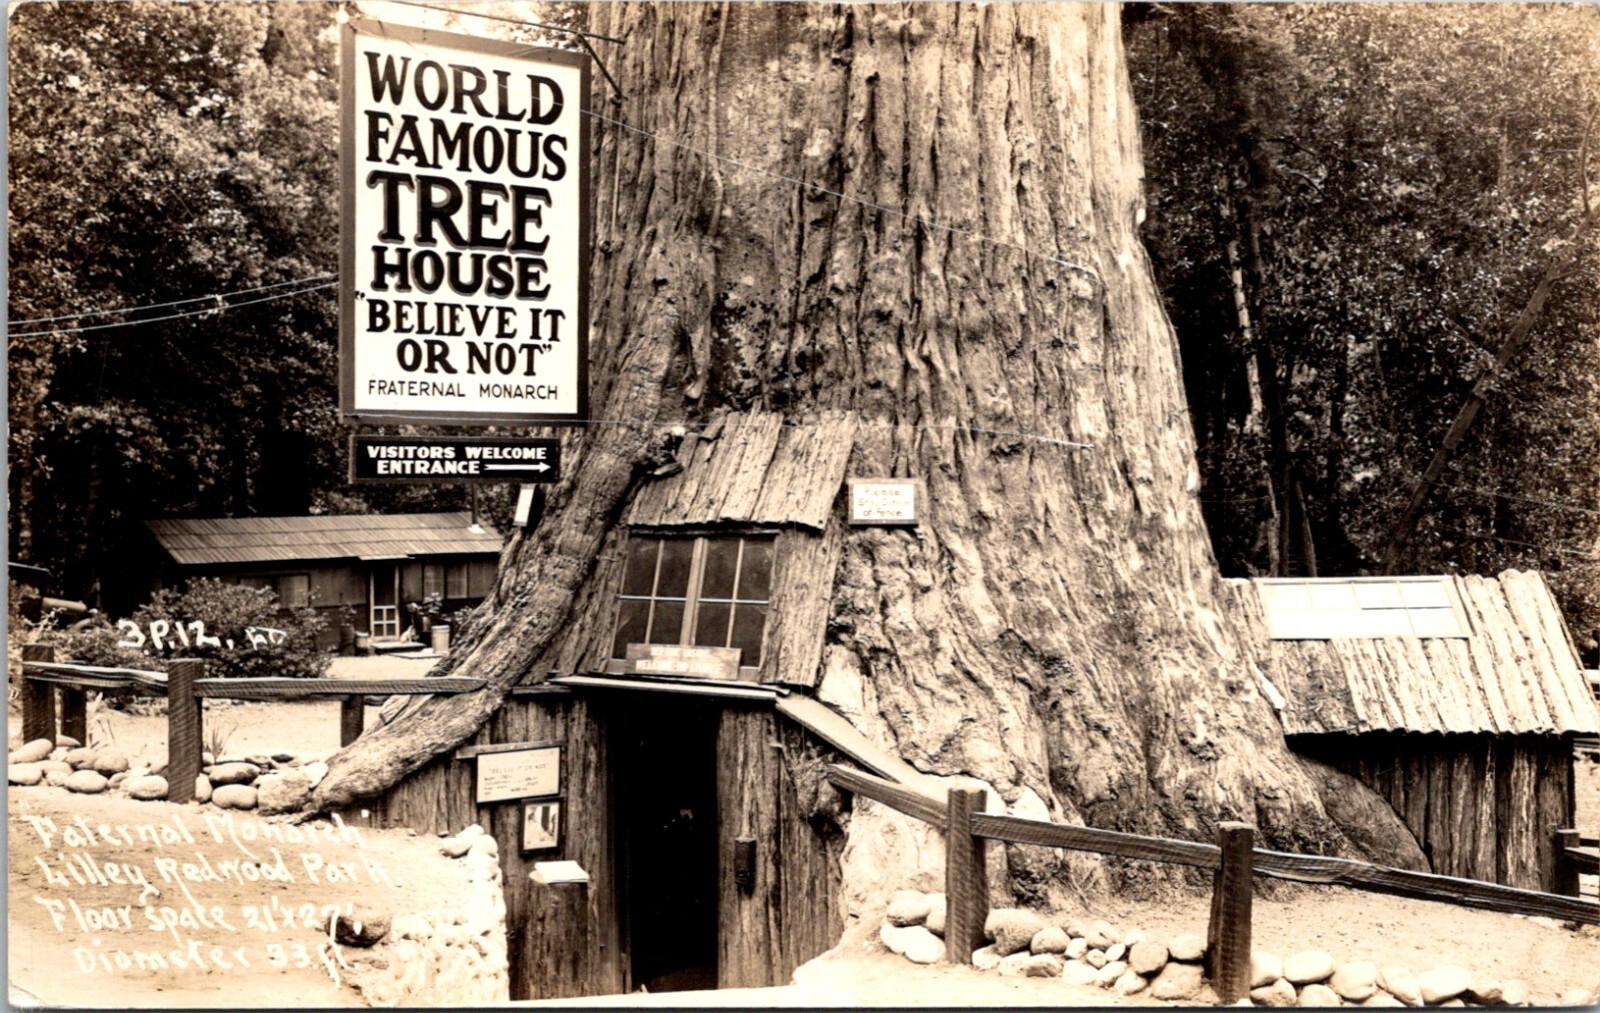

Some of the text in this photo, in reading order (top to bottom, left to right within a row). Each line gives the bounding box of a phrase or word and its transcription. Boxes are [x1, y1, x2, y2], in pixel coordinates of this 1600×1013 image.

[364, 51, 564, 125] WORLD
[364, 110, 568, 182] FAMOUS
[366, 170, 552, 256] TREE
[371, 245, 551, 301] HOUSE
[529, 308, 566, 342] IT
[397, 338, 552, 376] OR NOT"
[369, 380, 558, 400] FRATERNAL MONARCH
[367, 446, 547, 460] VISITORS WELCOME
[377, 460, 480, 475] ENTRANCE
